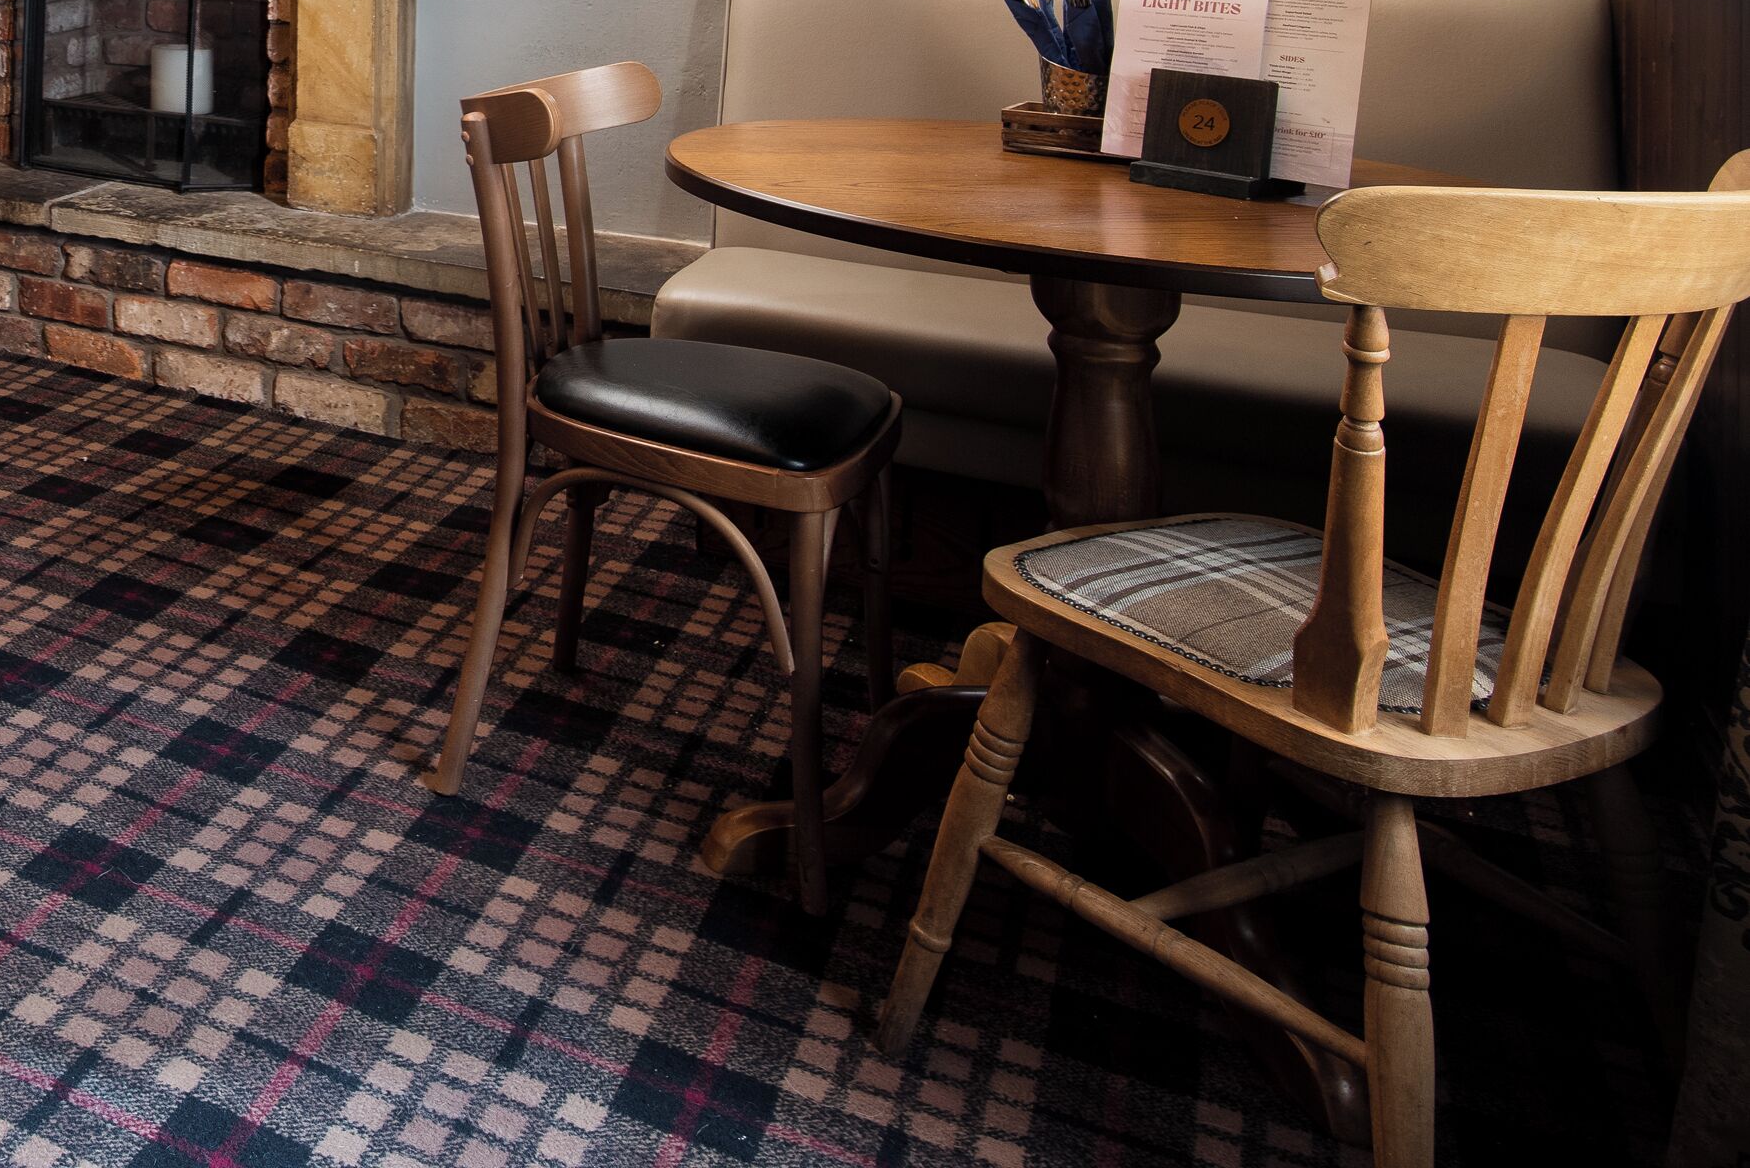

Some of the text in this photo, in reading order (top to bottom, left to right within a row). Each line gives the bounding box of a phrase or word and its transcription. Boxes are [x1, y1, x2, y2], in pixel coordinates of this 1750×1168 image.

[1193, 0, 1242, 16] BITES
[1279, 54, 1305, 64] SIDES
[1192, 114, 1215, 131] 24
